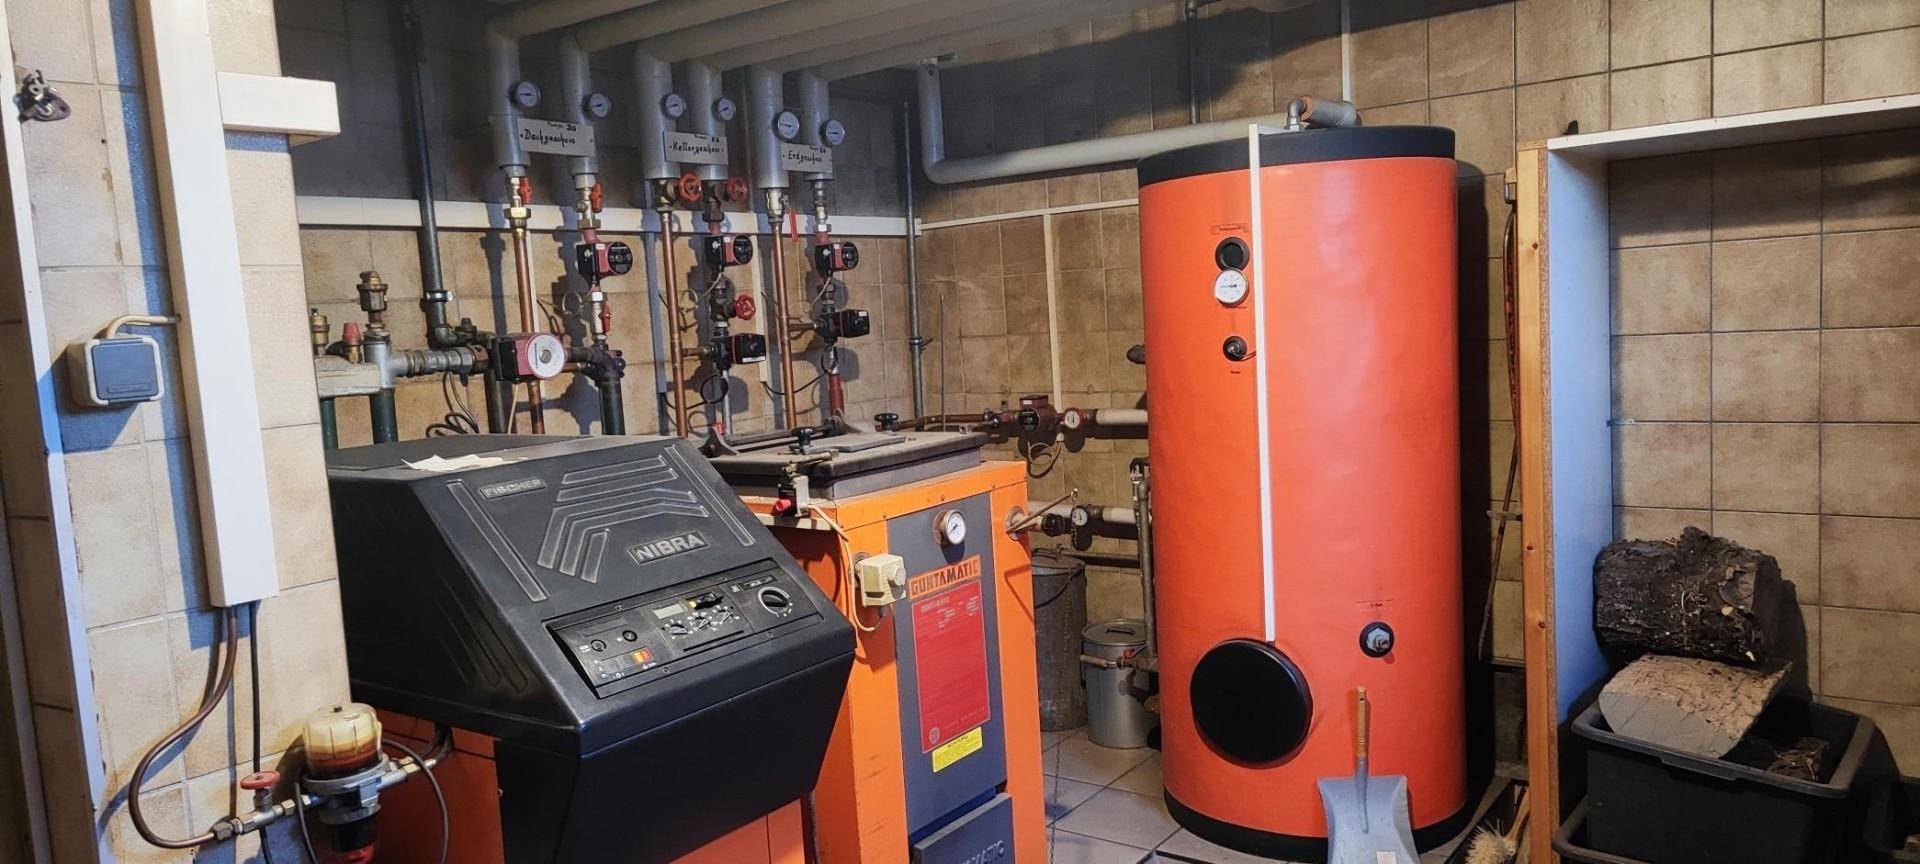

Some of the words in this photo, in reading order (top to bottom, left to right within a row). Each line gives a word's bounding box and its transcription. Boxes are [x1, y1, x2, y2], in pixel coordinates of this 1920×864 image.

[483, 479, 541, 497] FISCHER
[636, 534, 706, 561] NIBRA
[910, 559, 979, 597] GUNTAMATIC
